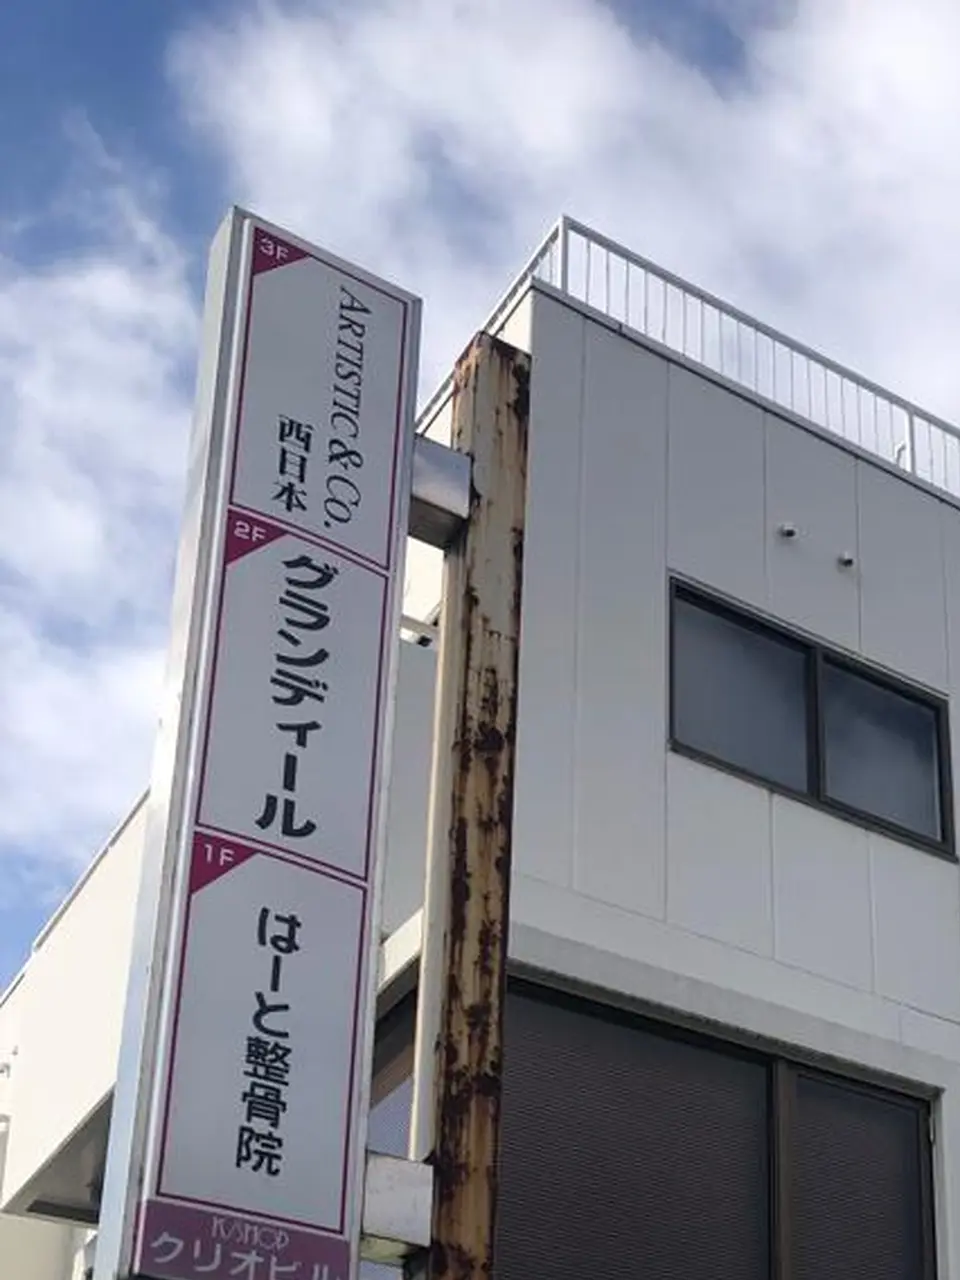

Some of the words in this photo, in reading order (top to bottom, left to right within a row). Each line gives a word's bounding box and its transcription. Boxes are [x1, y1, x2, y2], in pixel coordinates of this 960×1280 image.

[260, 237, 290, 260] 3F
[271, 414, 314, 512] 西日本
[232, 521, 267, 543] 2F
[255, 553, 340, 839] グランディール
[202, 843, 235, 866] 1F
[235, 906, 302, 1178] はーと整骨院
